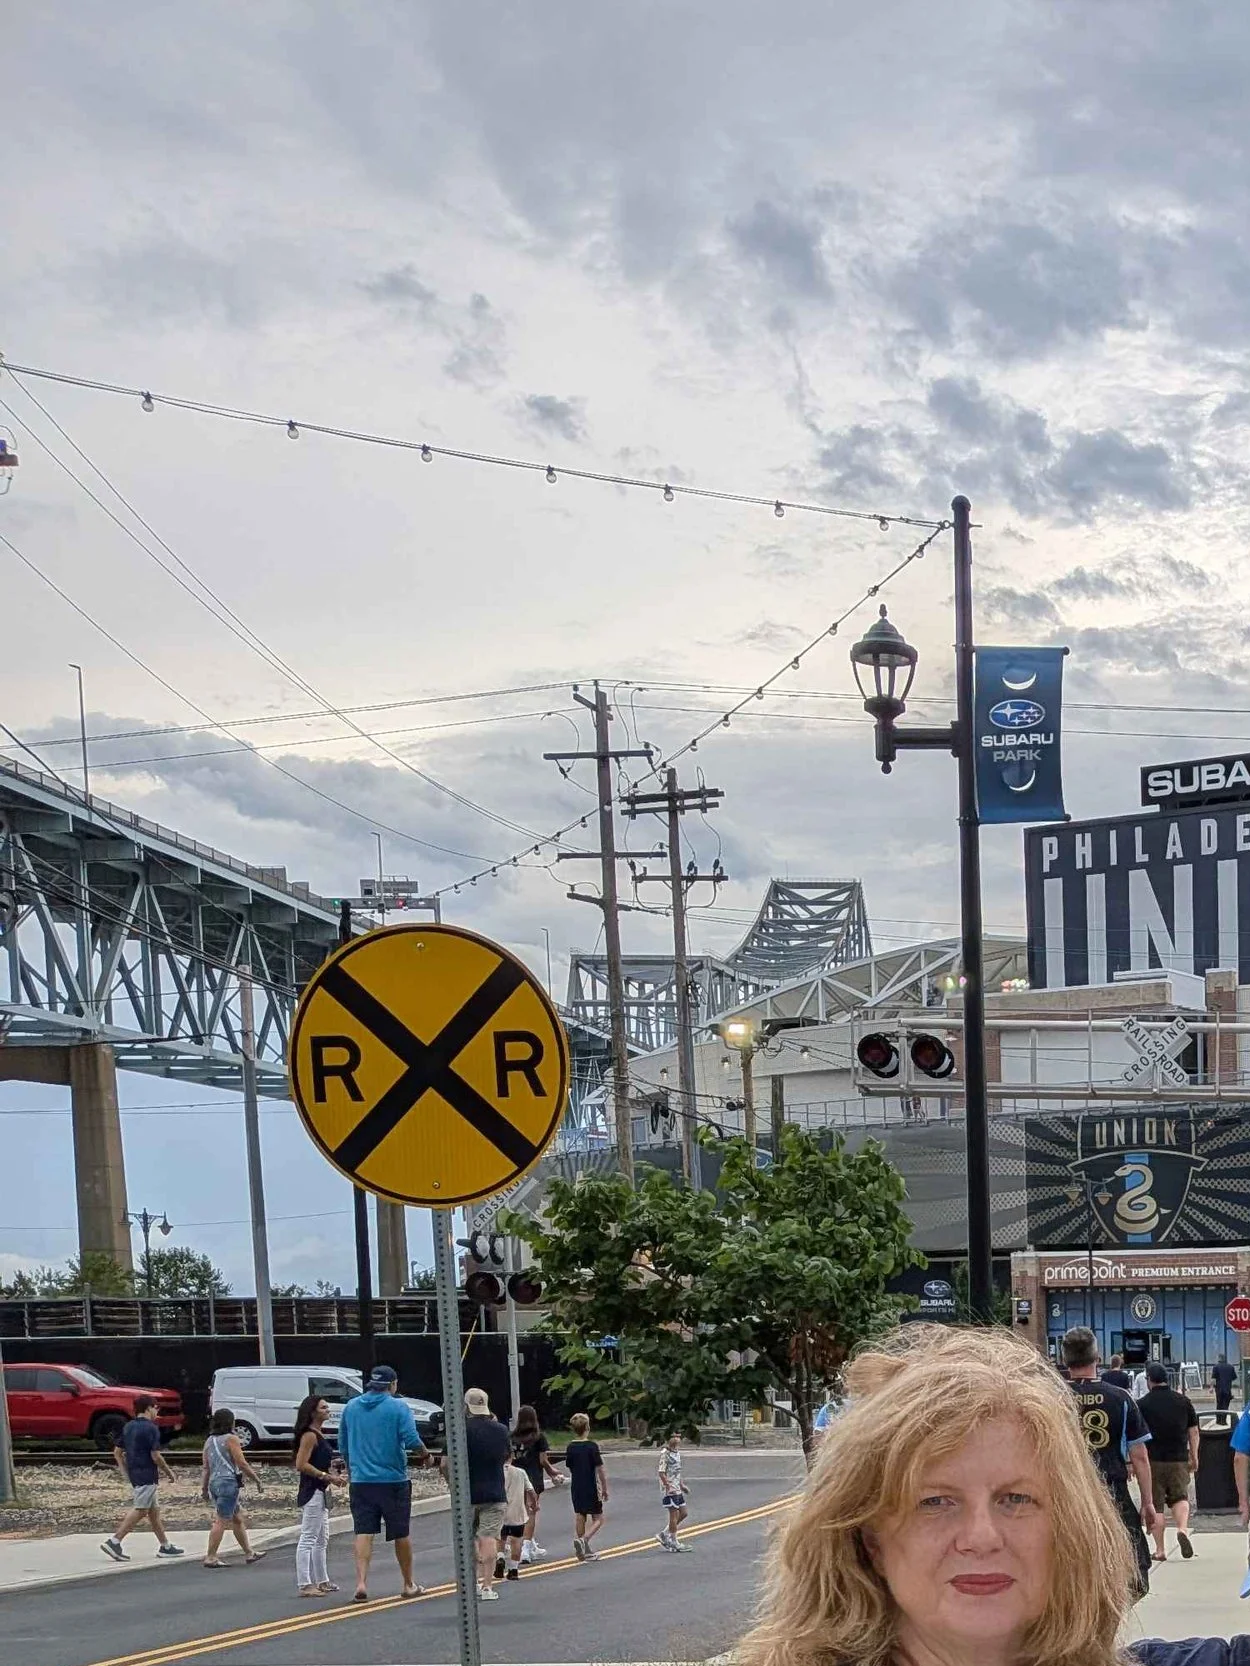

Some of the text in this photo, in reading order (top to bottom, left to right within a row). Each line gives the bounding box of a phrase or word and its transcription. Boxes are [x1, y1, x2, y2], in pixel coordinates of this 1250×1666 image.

[981, 732, 1054, 748] SUBARU
[992, 749, 1042, 763] PARK
[309, 1030, 548, 1103] R R
[1123, 1019, 1187, 1084] CROSSING
[1095, 1117, 1177, 1149] UNION
[1044, 1257, 1237, 1285] primepoint PREMIUM ENTRANCE
